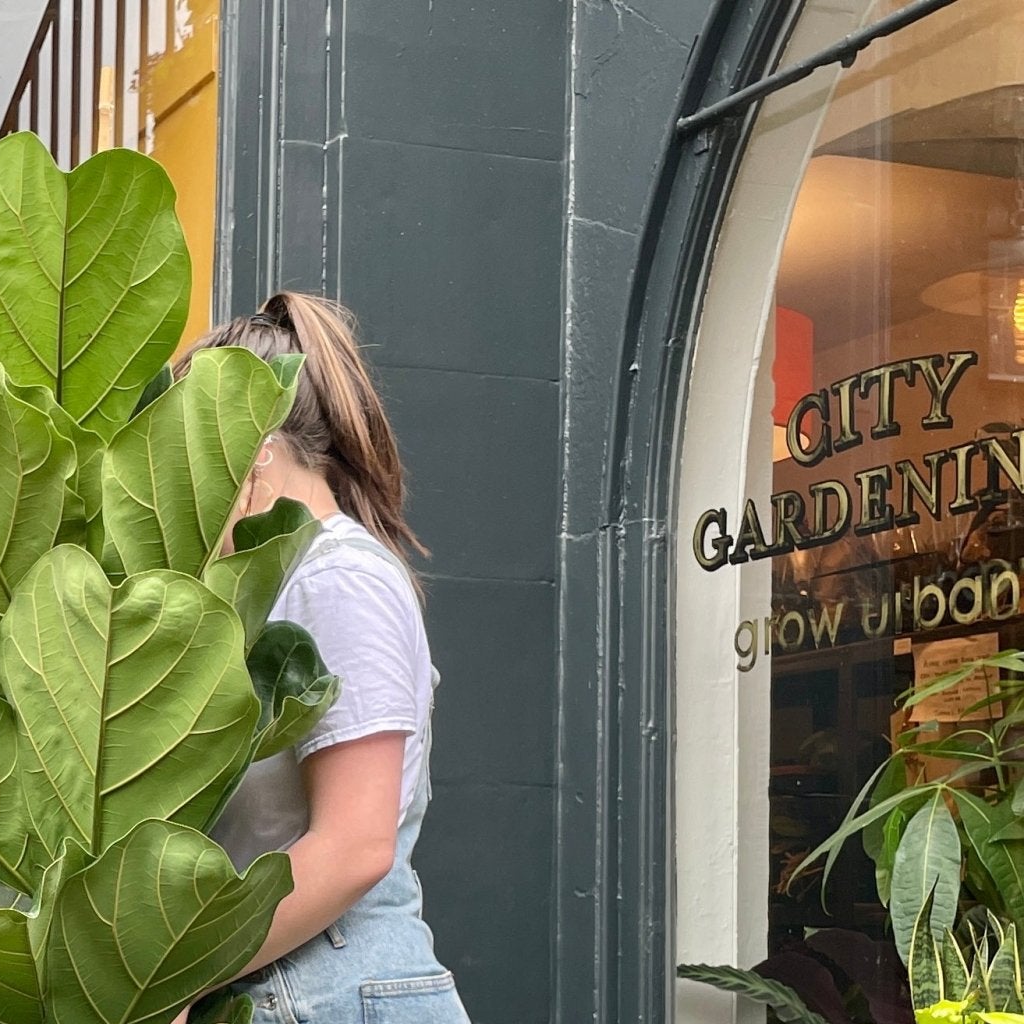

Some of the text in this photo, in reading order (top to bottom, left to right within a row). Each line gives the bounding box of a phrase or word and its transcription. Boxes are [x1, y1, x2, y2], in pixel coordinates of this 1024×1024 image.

[786, 352, 977, 467] CITY
[693, 430, 1024, 571] GARDENIN
[734, 570, 1020, 672] grow urban
